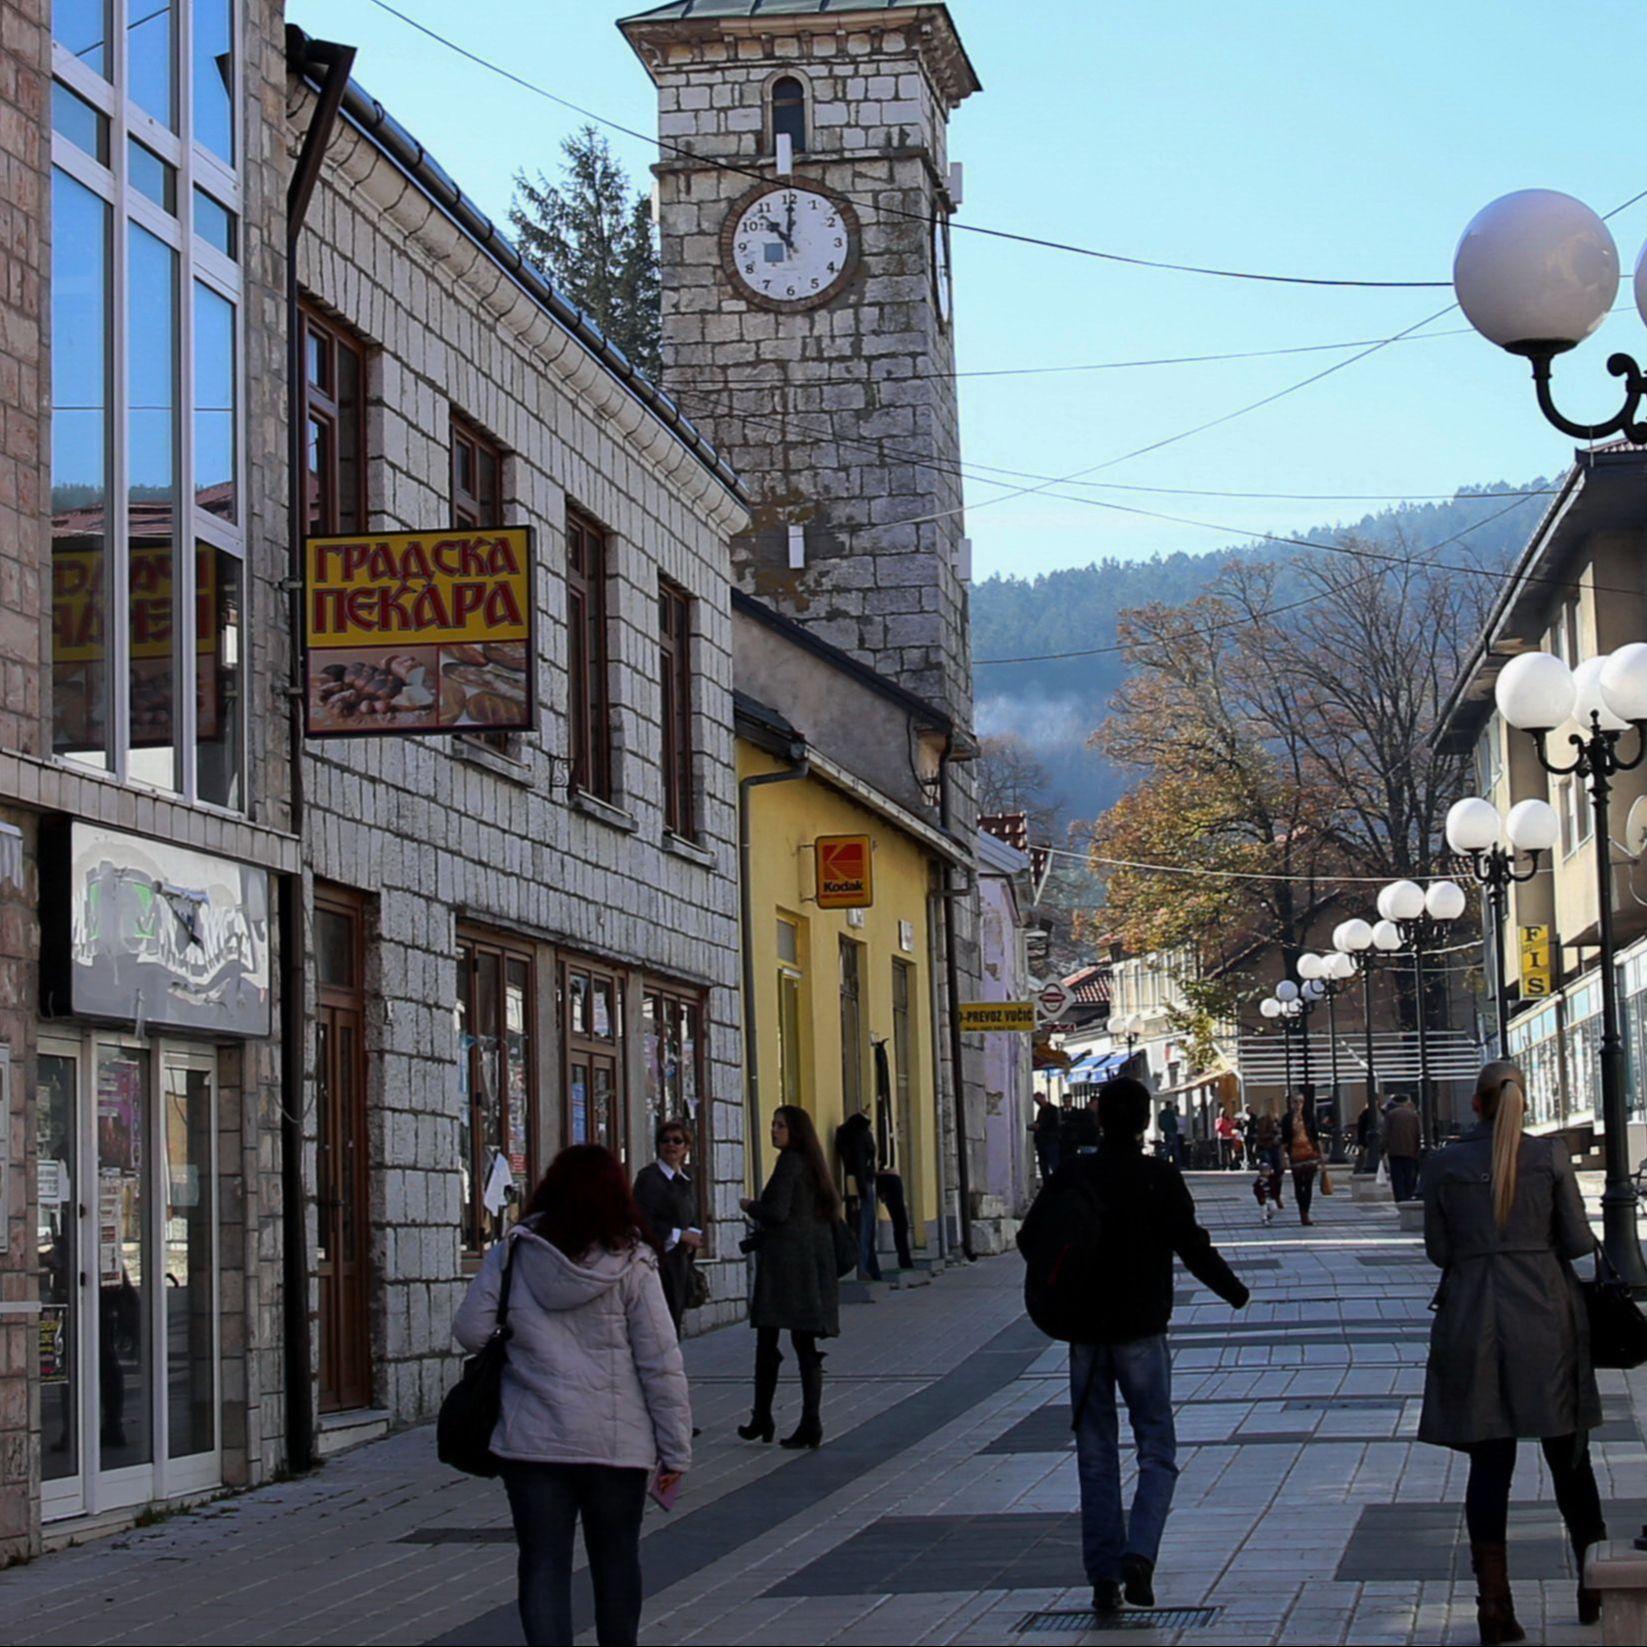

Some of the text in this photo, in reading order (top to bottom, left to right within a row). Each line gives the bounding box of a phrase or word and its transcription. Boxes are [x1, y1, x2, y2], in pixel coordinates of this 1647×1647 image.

[781, 193, 798, 205] 12
[757, 203, 771, 213] 11
[810, 200, 818, 211] 1
[742, 221, 758, 233] 10
[825, 217, 836, 228] 2
[738, 242, 747, 253] 9
[833, 237, 842, 248] 3
[745, 263, 754, 274] 8
[826, 261, 835, 274] 4
[762, 280, 771, 290] 7
[810, 278, 819, 289] 5
[786, 286, 795, 296] 6
[314, 536, 521, 585] ГРАДСКА
[312, 580, 524, 634] ПЕКАРА
[823, 880, 864, 893] Kodak
